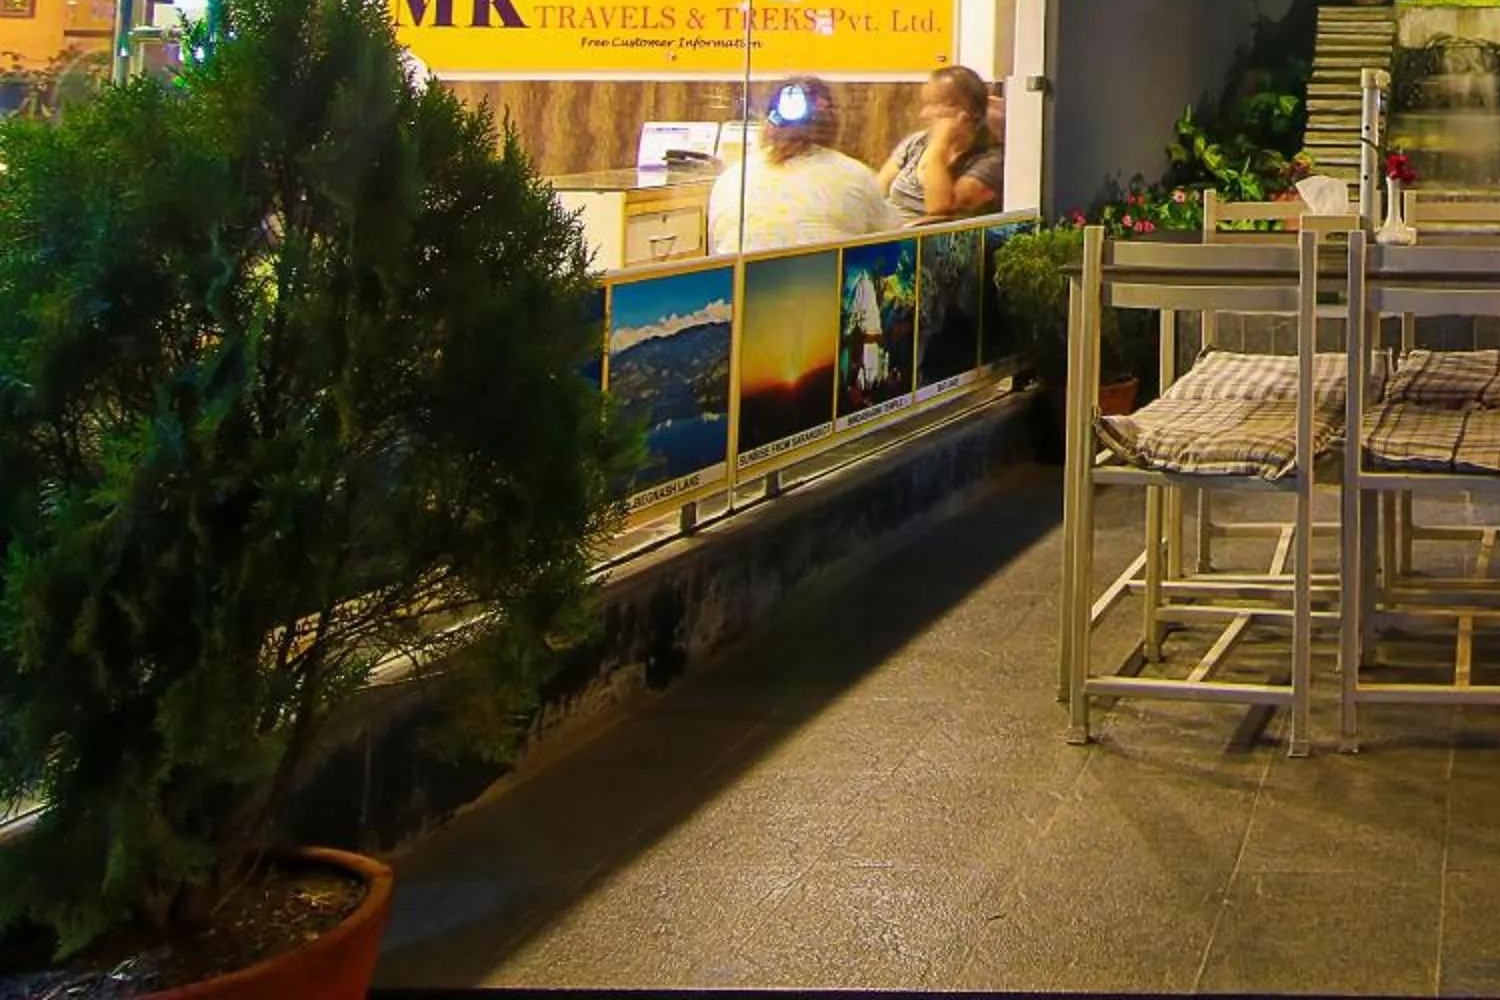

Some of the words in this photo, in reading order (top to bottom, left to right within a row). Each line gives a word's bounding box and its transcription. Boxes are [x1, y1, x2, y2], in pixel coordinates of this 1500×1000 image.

[533, 5, 677, 30] TRAVELS
[685, 7, 706, 30] &
[717, 6, 818, 31] TREKS
[832, 7, 879, 32] Pvt.
[892, 9, 942, 34] Ltd.
[580, 36, 610, 48] Free
[611, 36, 675, 48] Customer
